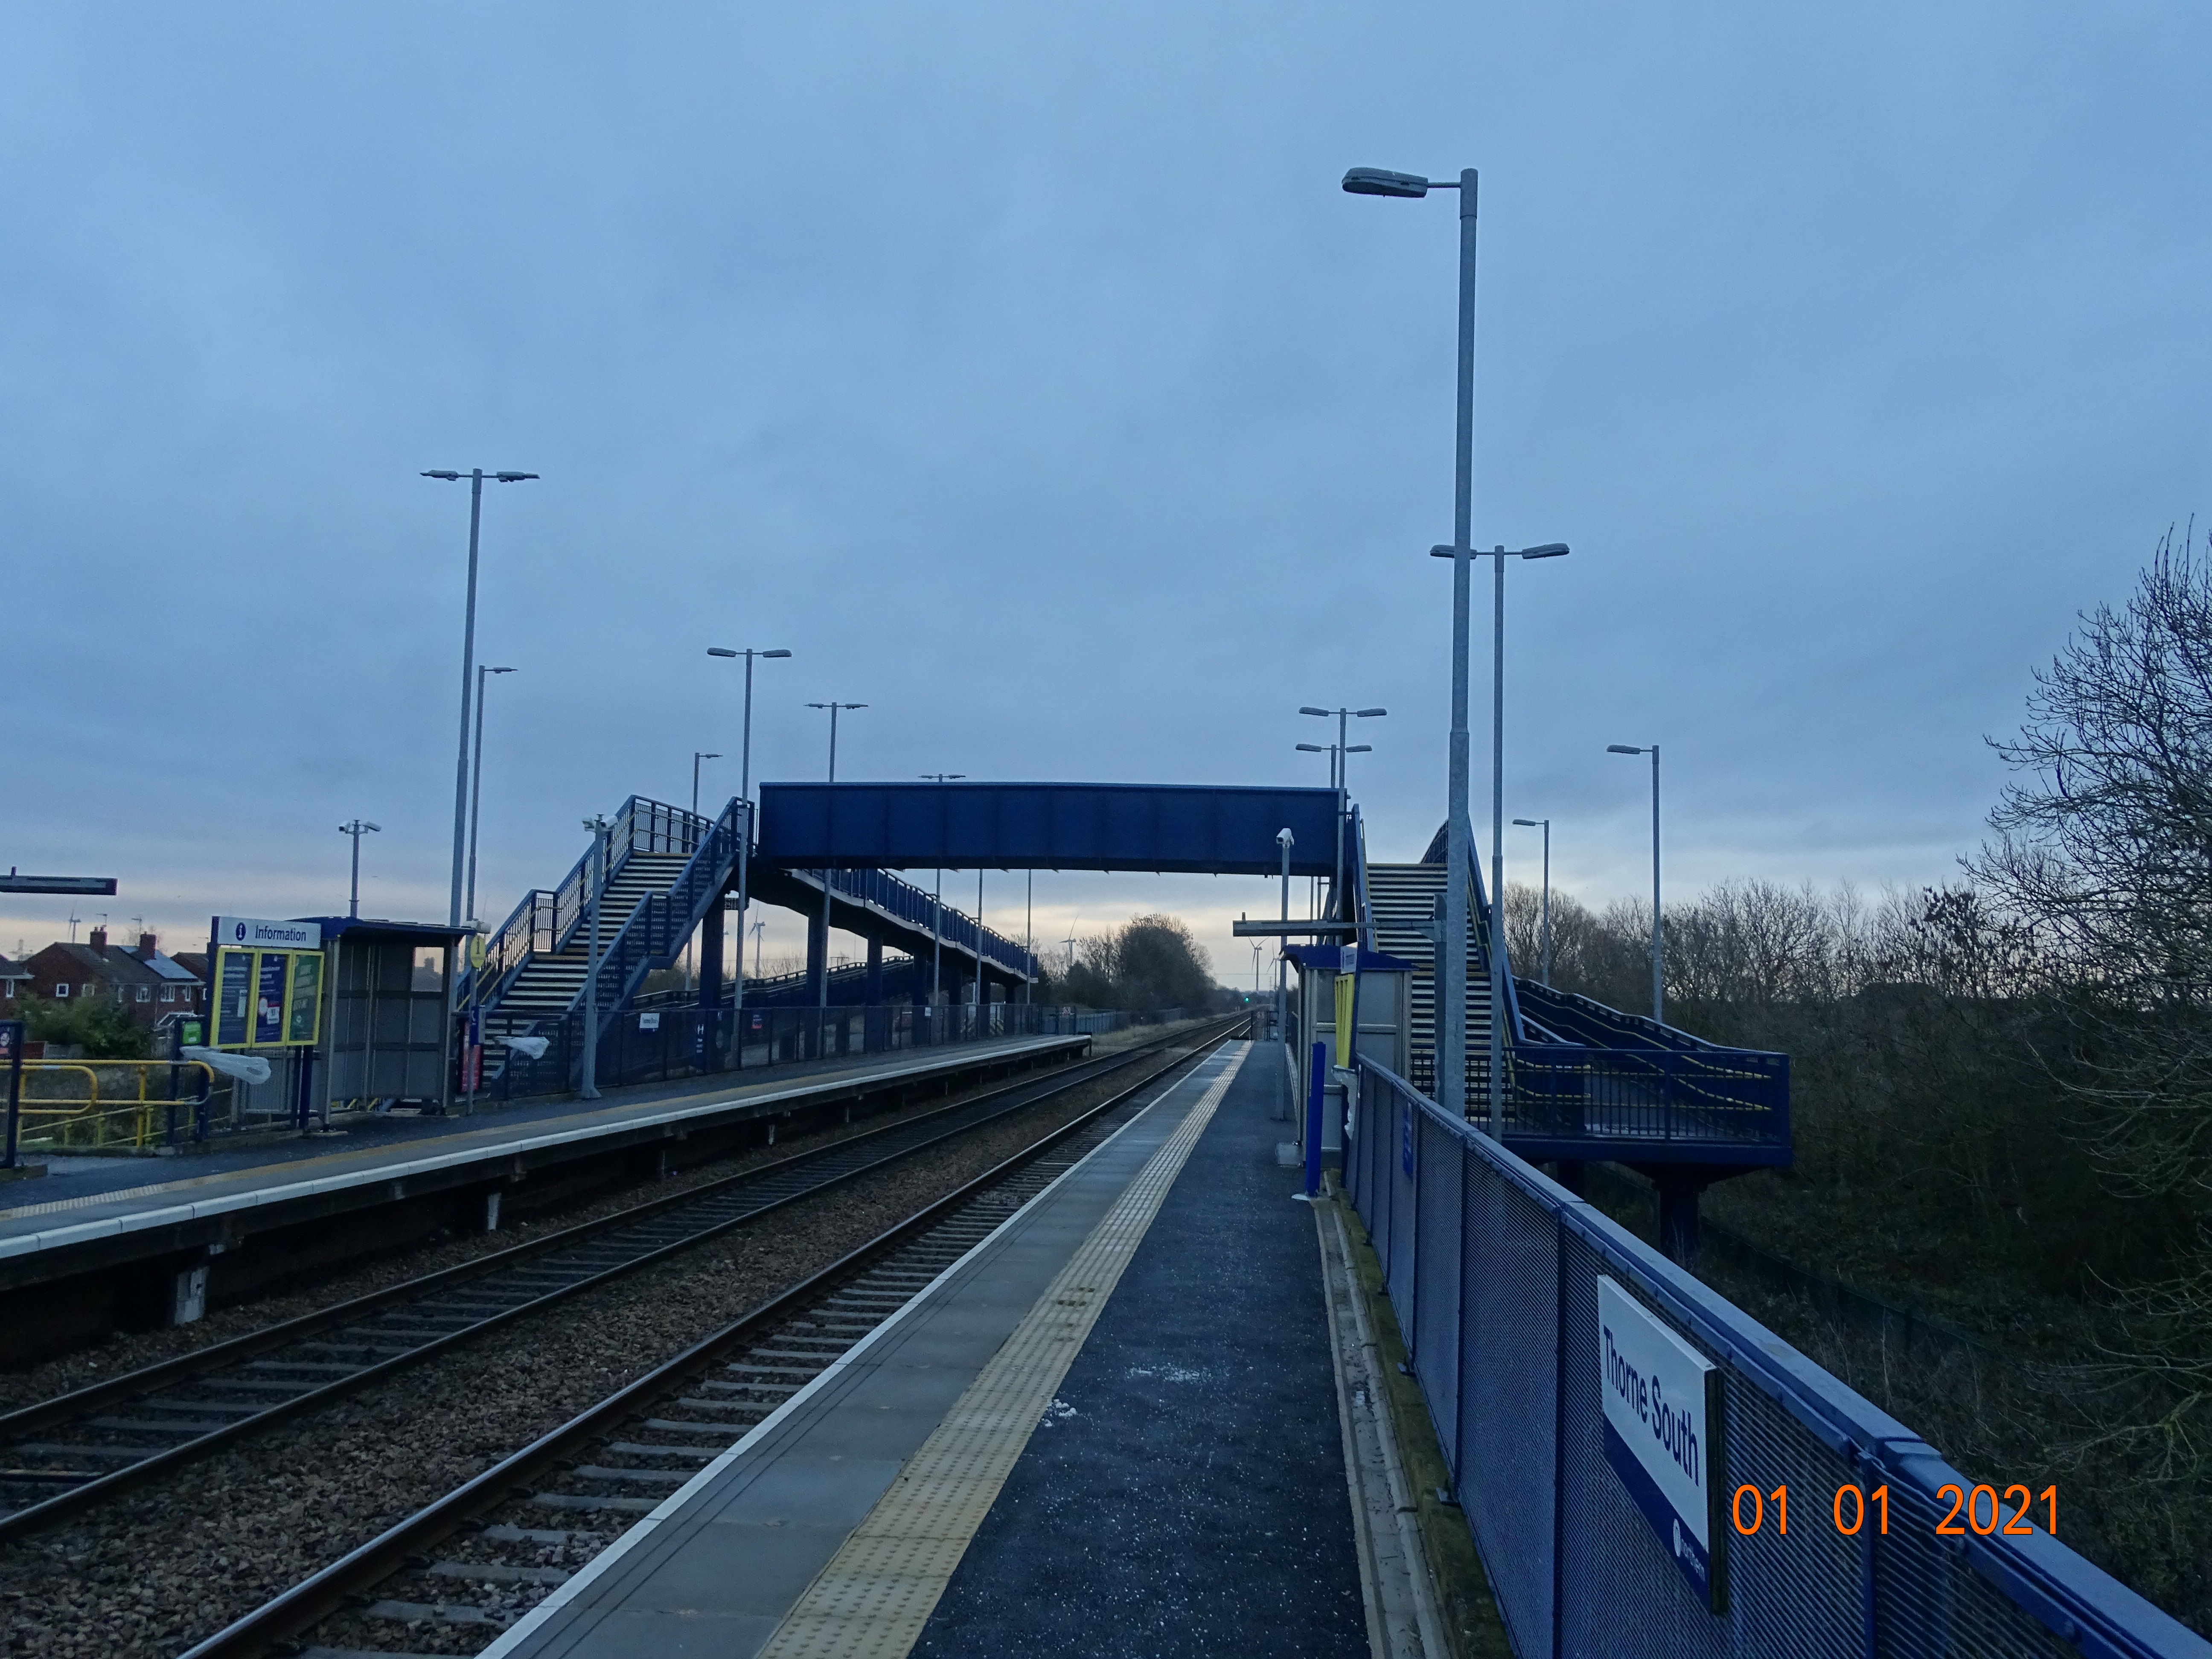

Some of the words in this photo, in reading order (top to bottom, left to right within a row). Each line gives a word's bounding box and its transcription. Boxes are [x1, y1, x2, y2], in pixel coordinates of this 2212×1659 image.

[256, 925, 306, 941] Information
[1603, 1325, 1648, 1423] Thorne
[1652, 1375, 1699, 1487] South
